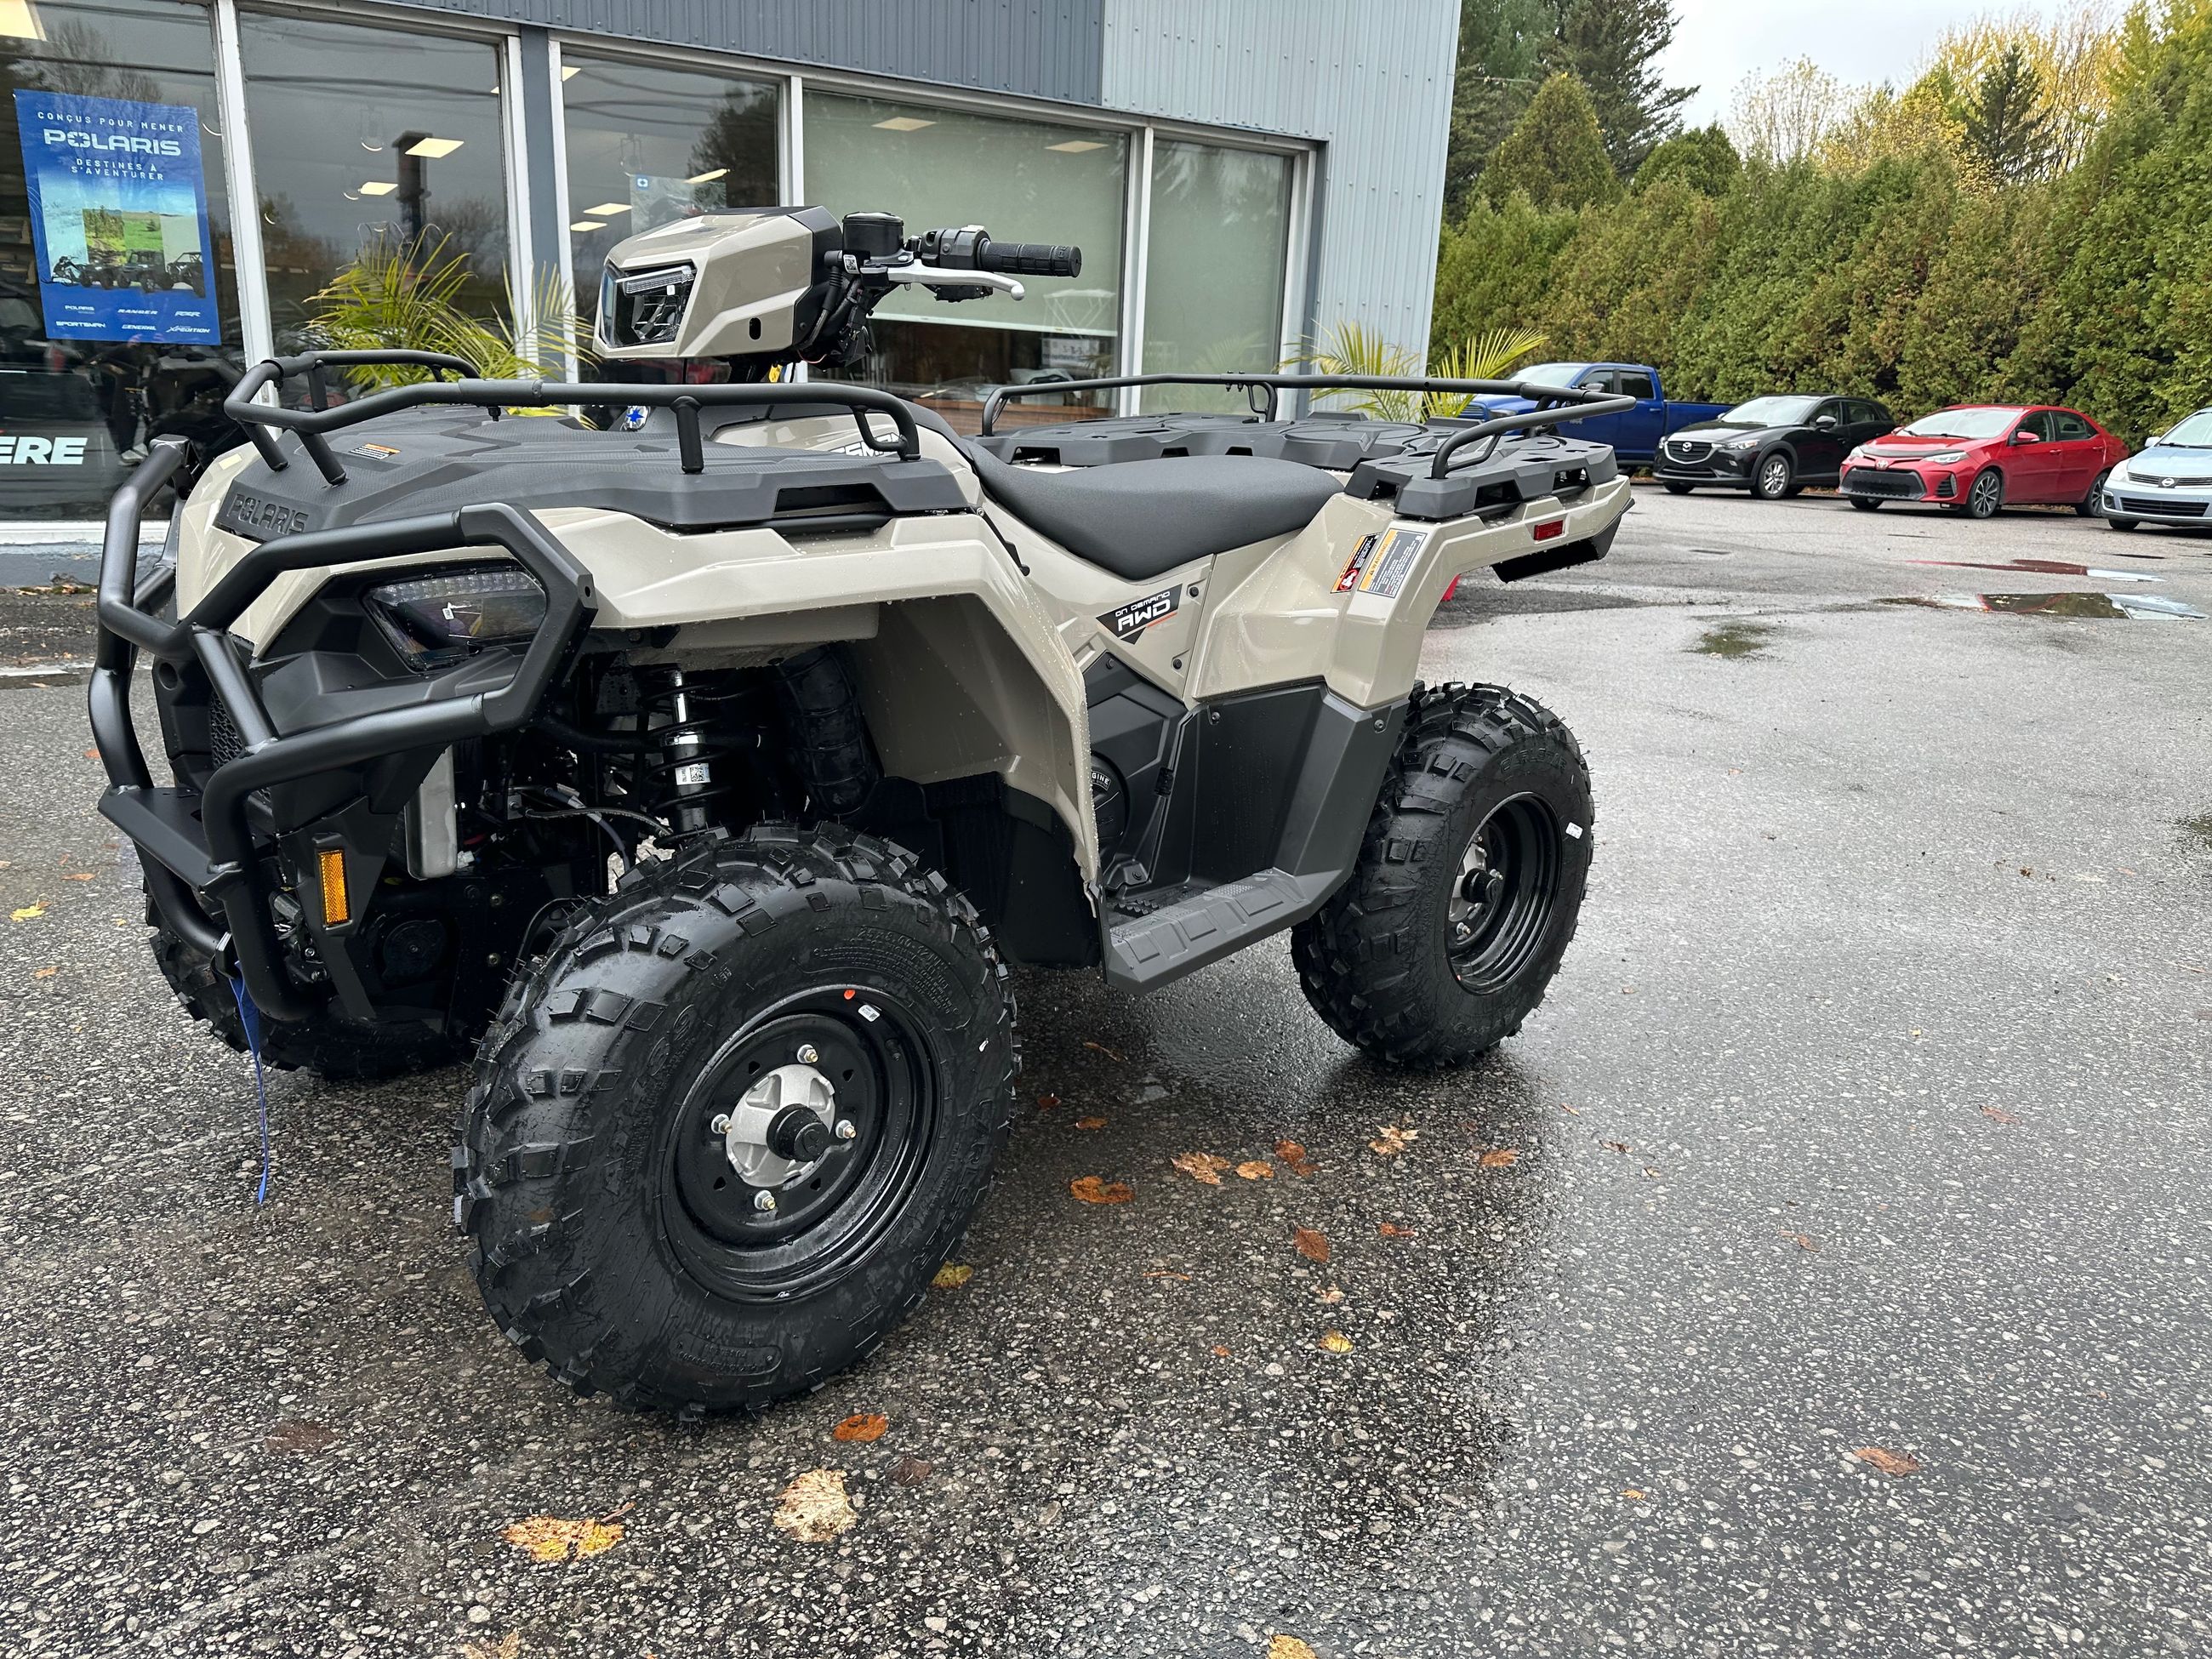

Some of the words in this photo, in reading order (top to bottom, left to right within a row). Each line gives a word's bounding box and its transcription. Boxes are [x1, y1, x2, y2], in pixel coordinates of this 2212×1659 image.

[37, 111, 91, 123] CONÇUS
[100, 118, 134, 128] POUR
[141, 122, 184, 133] MENER
[43, 128, 181, 157] POLARIS
[71, 166, 164, 180] S'AVENTURER
[227, 493, 309, 535] POLARIS
[1115, 607, 1128, 618] ON
[1131, 590, 1171, 610] DEMAND
[1117, 598, 1171, 632] AWD
